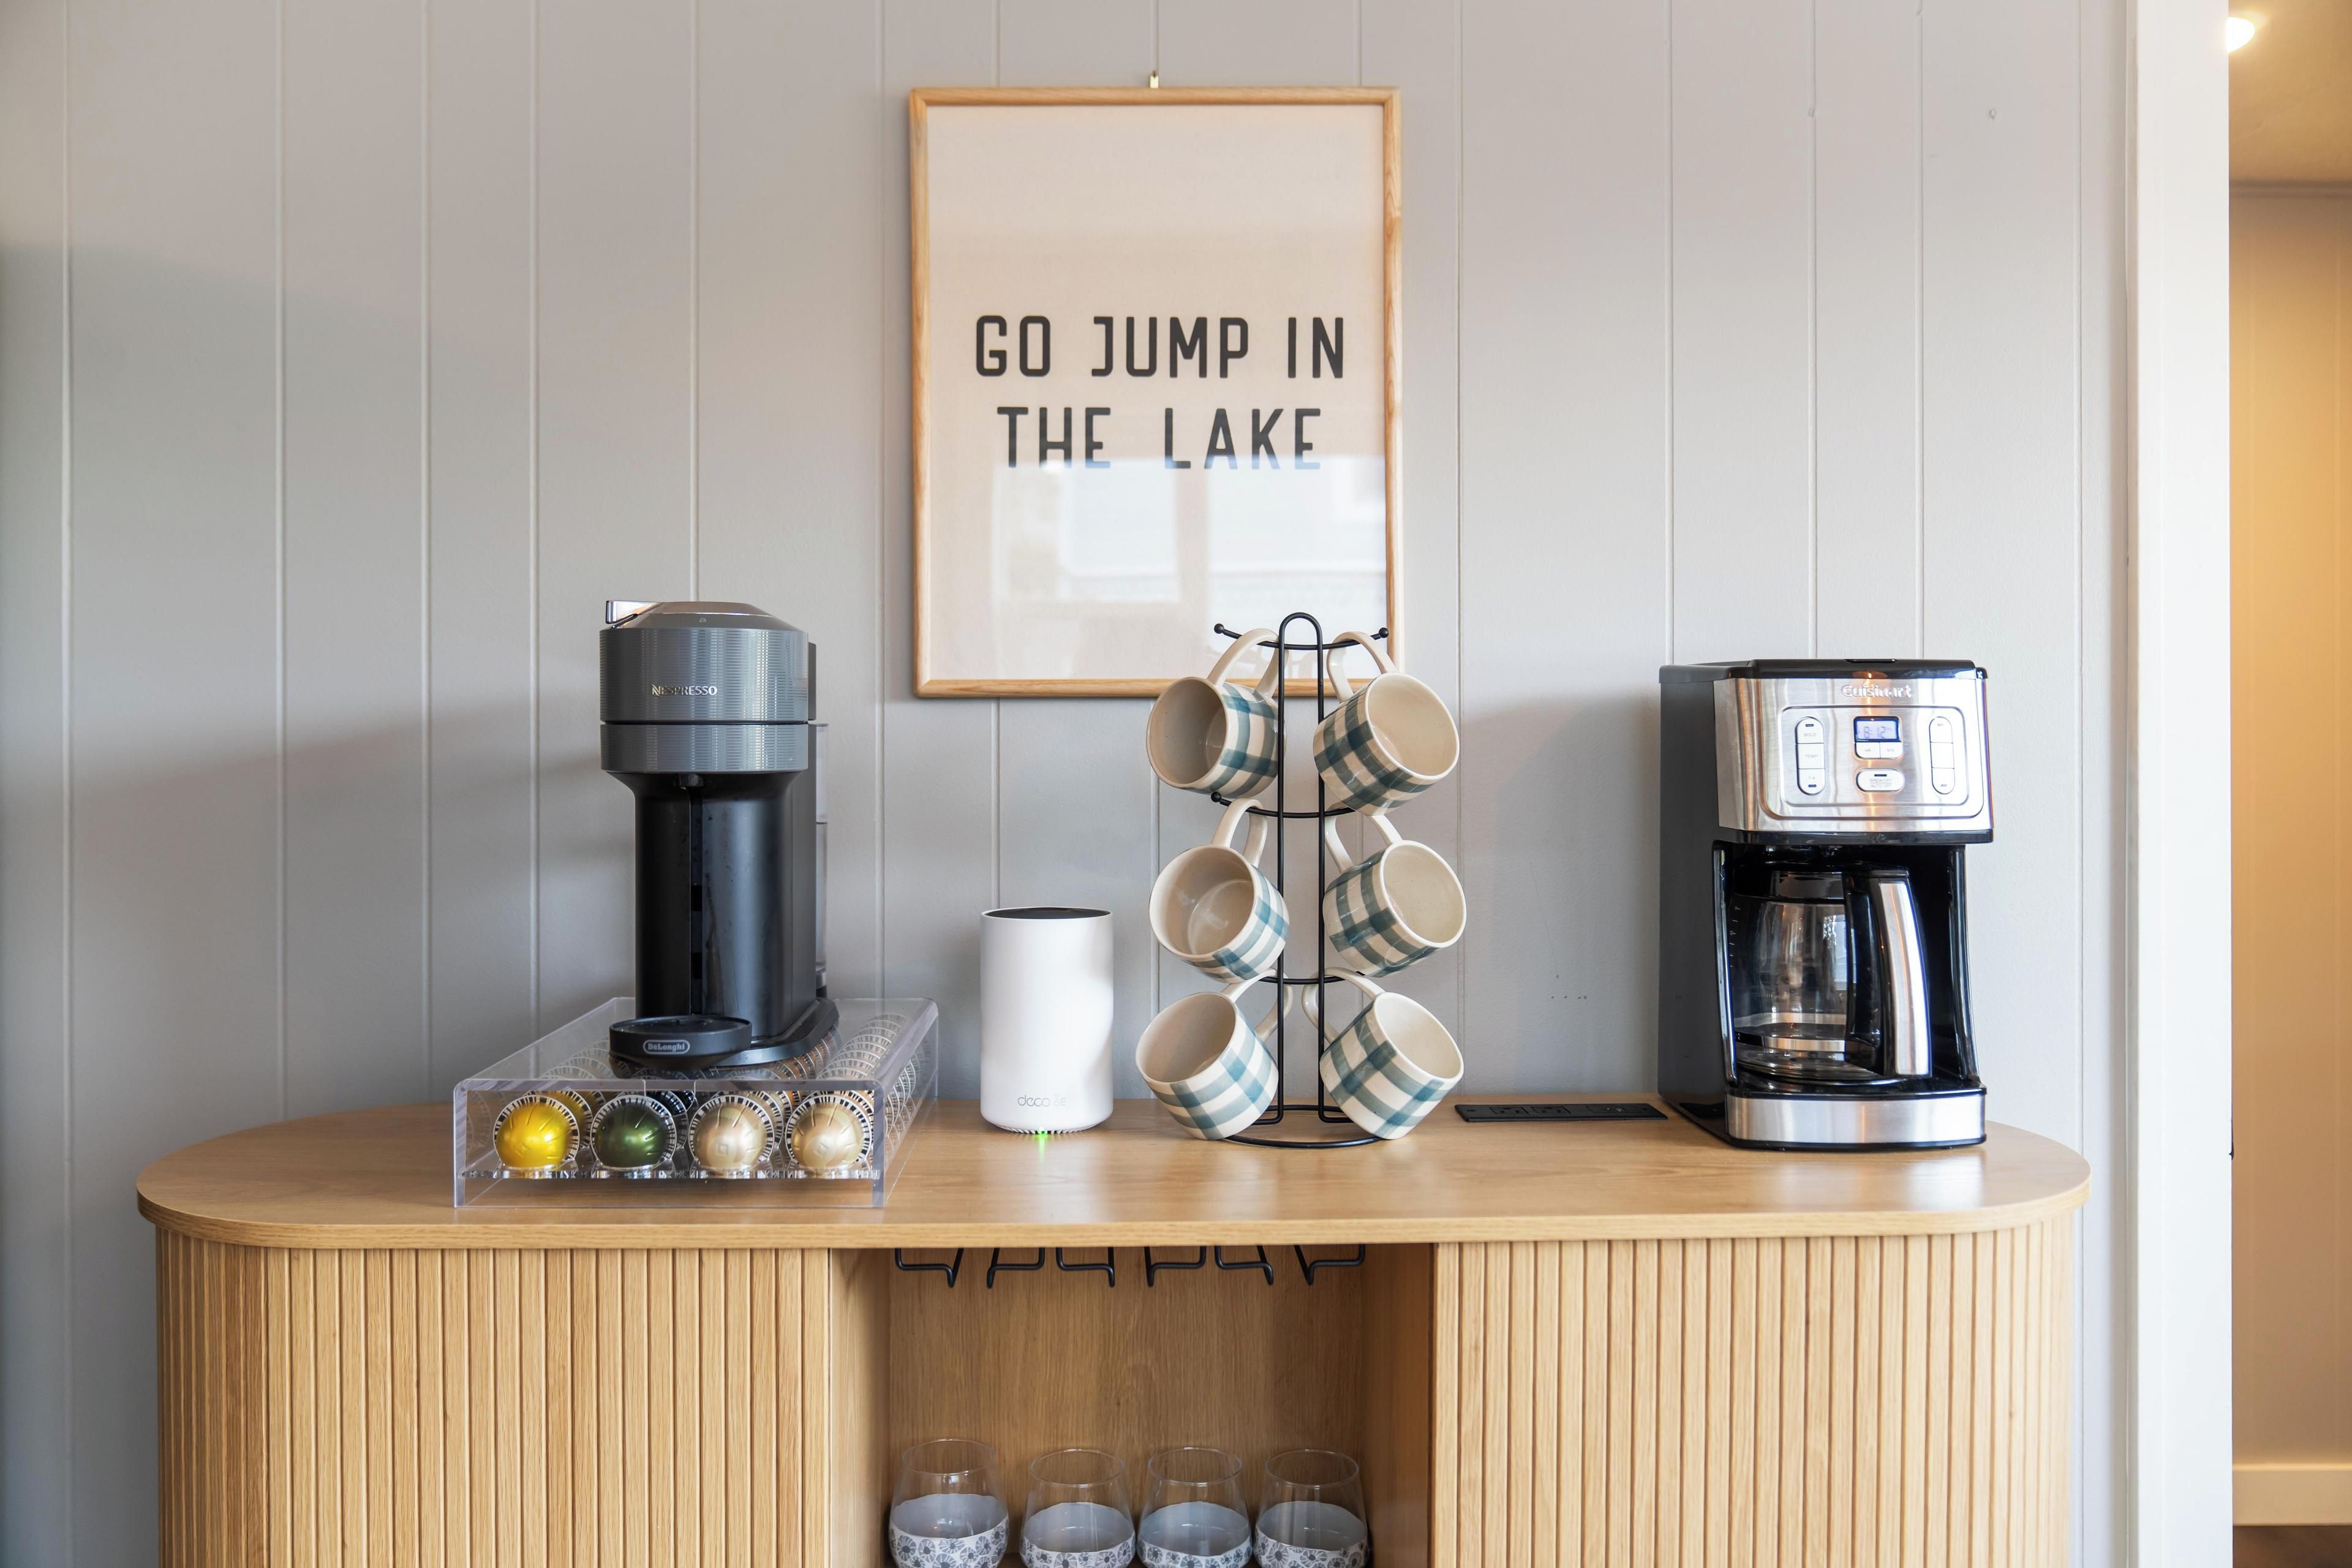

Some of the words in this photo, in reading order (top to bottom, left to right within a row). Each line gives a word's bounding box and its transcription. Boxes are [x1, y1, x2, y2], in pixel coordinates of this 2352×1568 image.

[976, 315, 1051, 377] GO
[1091, 316, 1250, 379] JUMP
[1287, 316, 1344, 379] IN
[997, 407, 1112, 469] THE
[1164, 407, 1322, 470] LAKE
[652, 684, 718, 697] NESPRESSO
[1842, 684, 1912, 697] Cuisinart
[648, 1043, 685, 1052] DeLonghi
[1017, 1094, 1050, 1107] deco
